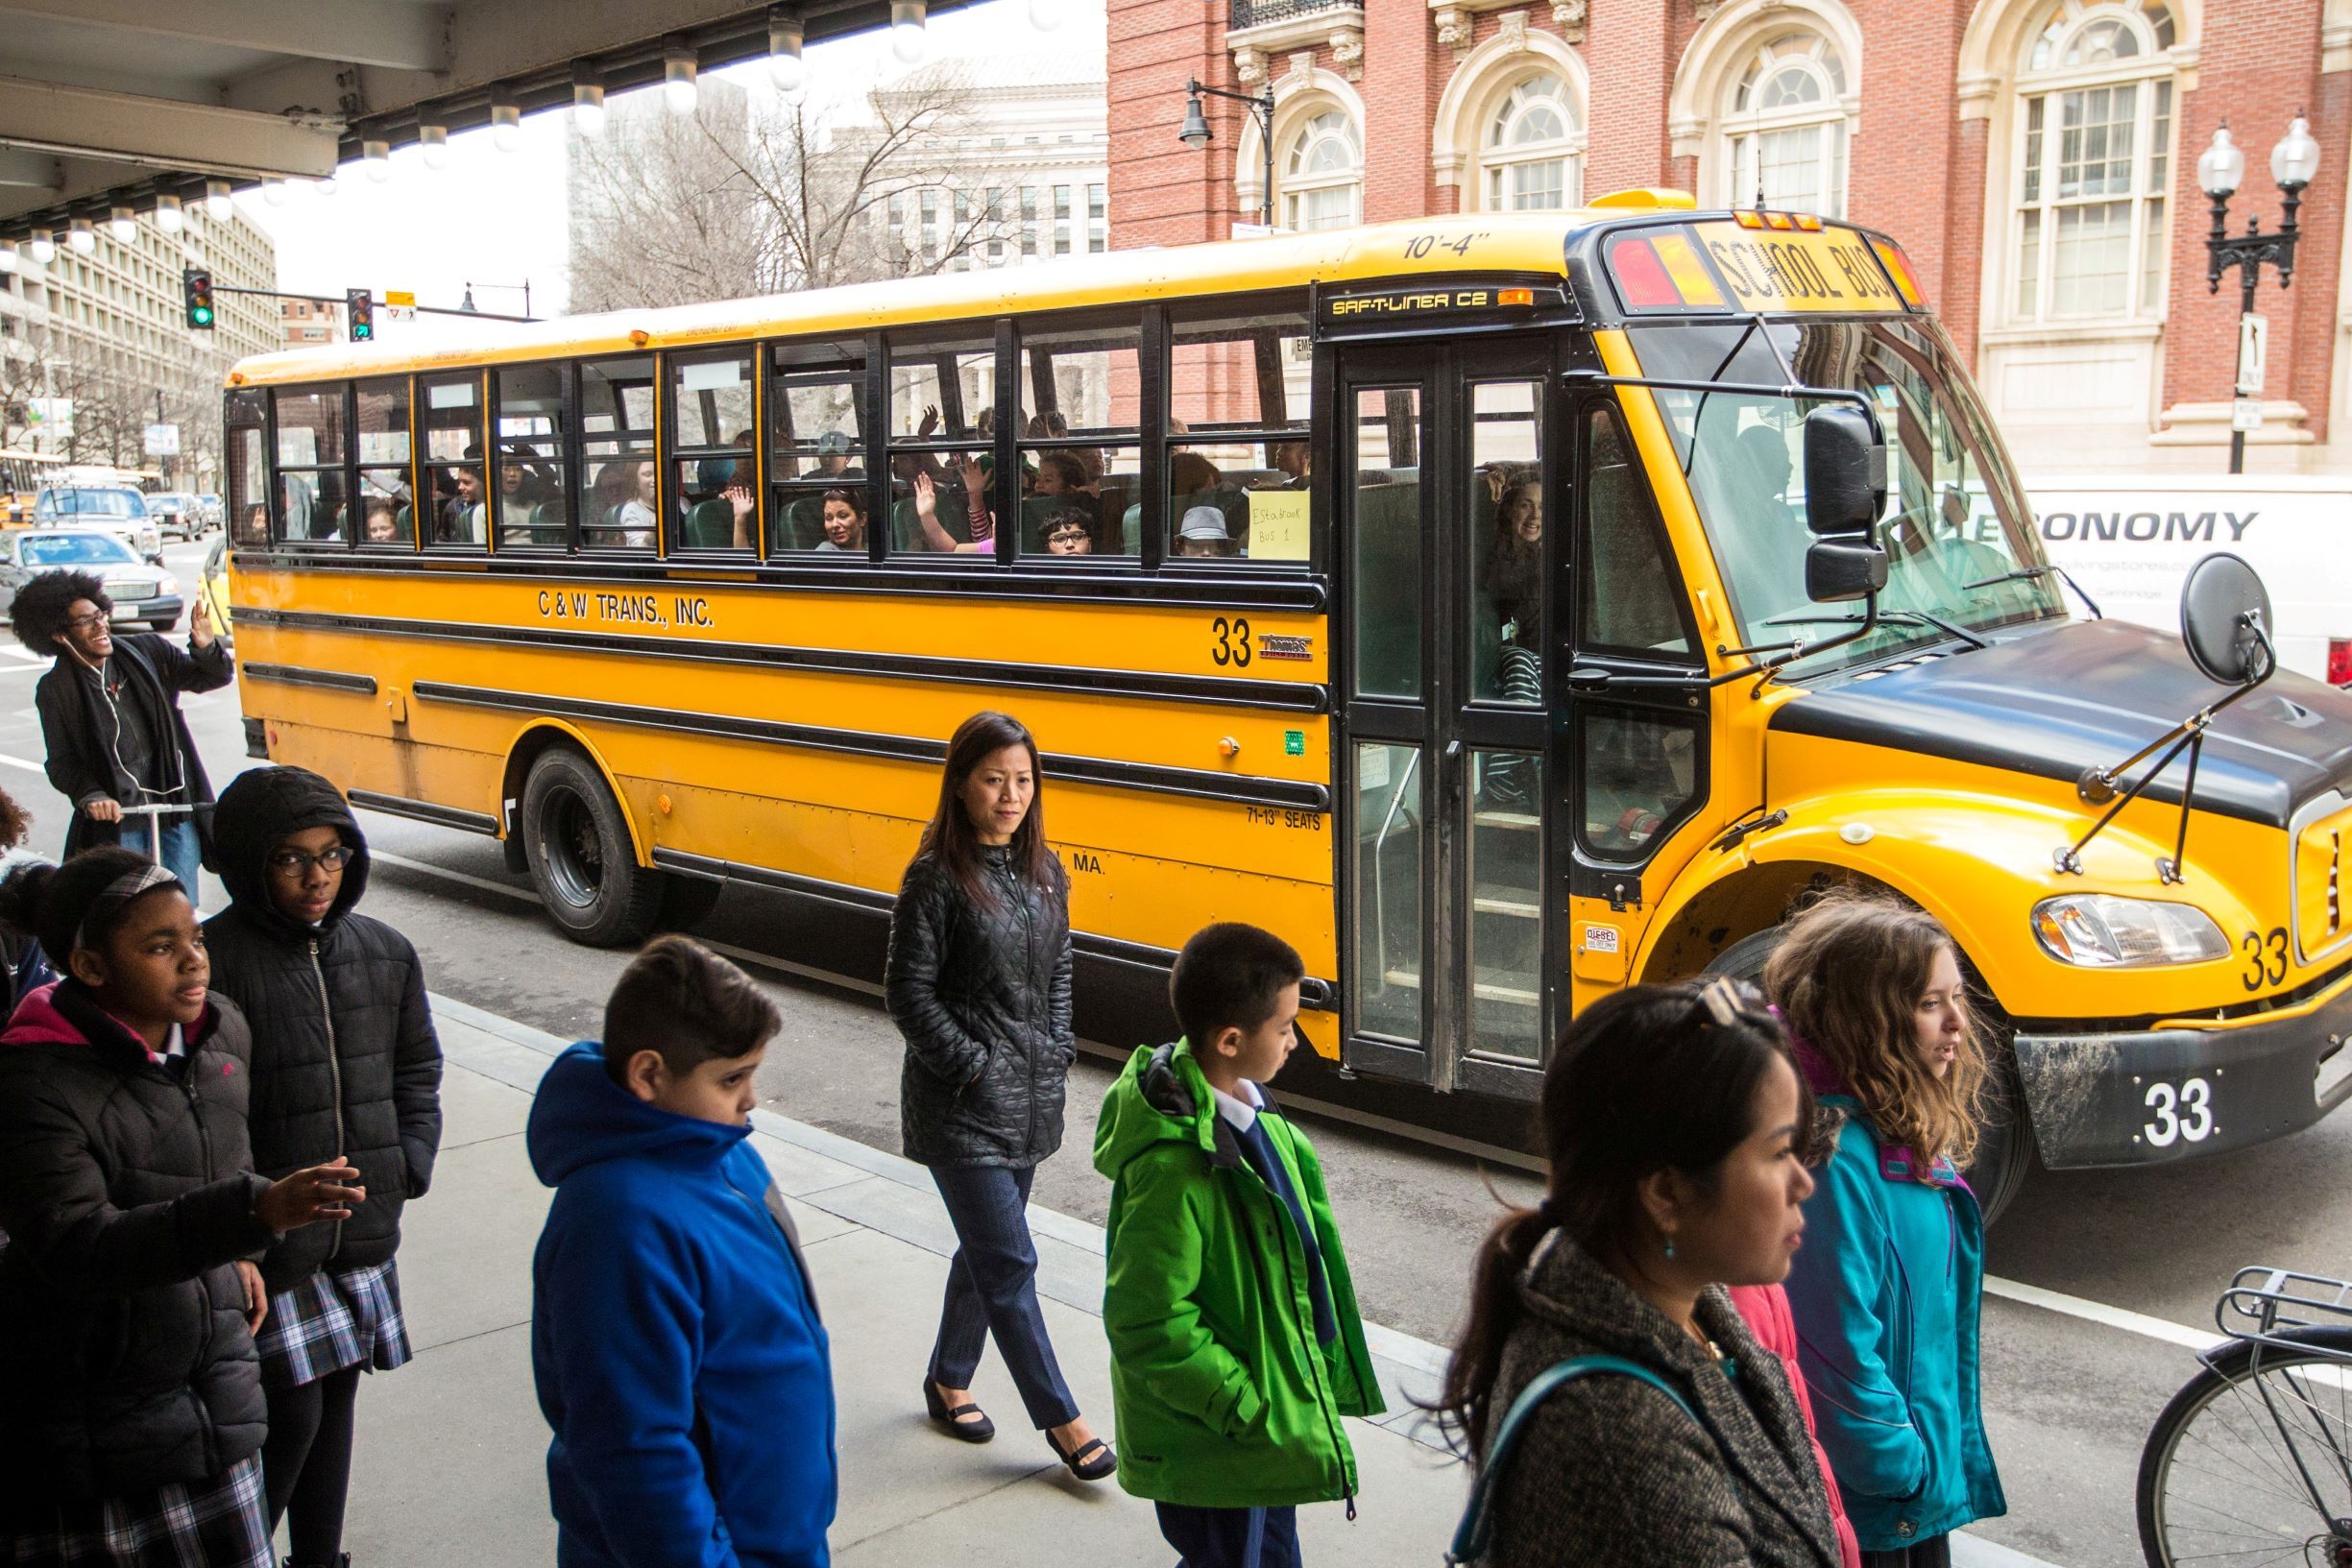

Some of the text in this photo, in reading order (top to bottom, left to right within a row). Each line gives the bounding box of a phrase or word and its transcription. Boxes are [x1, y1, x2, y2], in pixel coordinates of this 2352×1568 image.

[1709, 240, 1891, 298] SCHOOL BUS
[1456, 292, 1488, 306] C2
[1283, 528, 1291, 541] 1
[1975, 512, 2260, 542] EONOMY
[538, 590, 715, 630] C & W TRANS., INC.
[1212, 616, 1251, 667] 33
[1247, 807, 1321, 832] 71-13" SEATS
[1073, 853, 1105, 875] MA.
[1587, 929, 1615, 942] DIESEL
[2243, 927, 2289, 992] 33
[2144, 1076, 2213, 1147] 33
